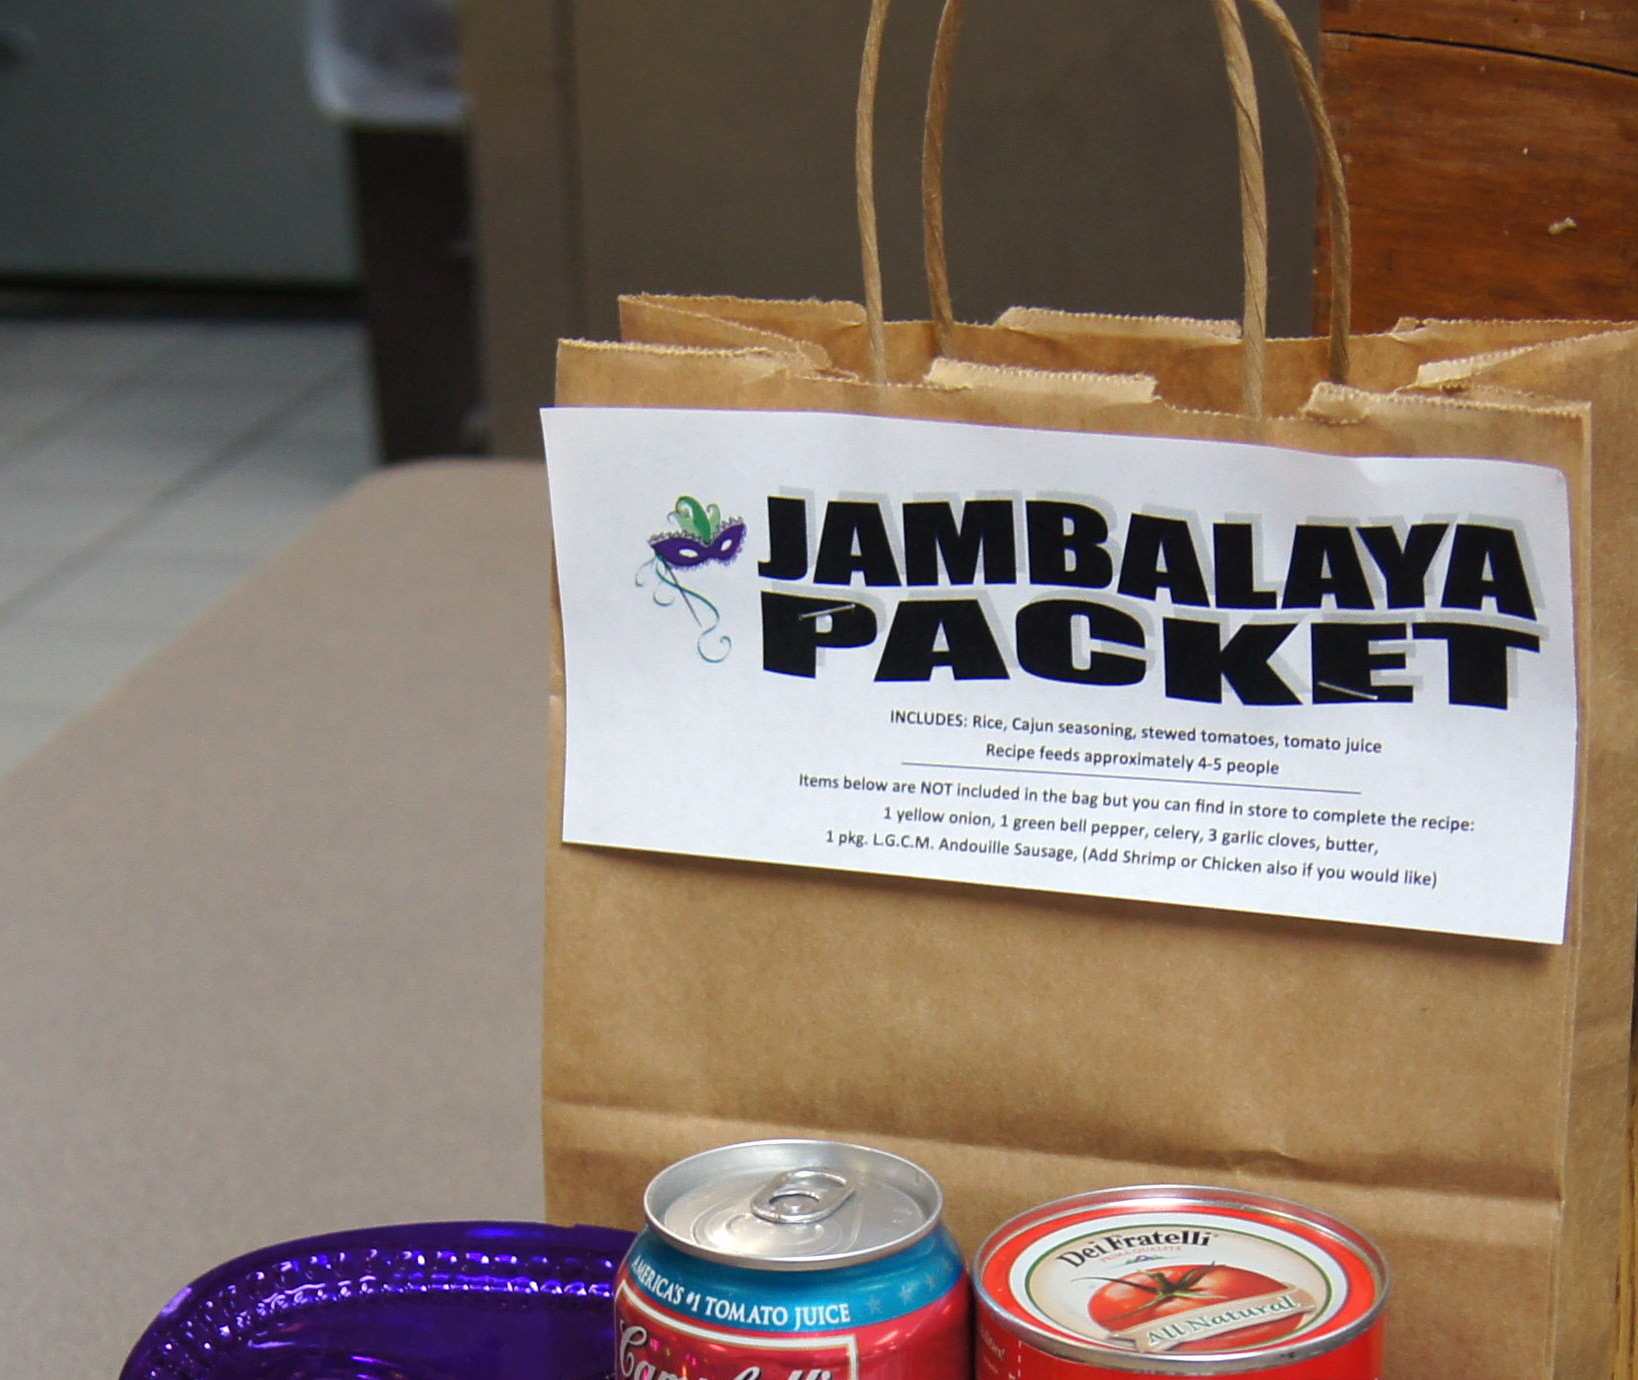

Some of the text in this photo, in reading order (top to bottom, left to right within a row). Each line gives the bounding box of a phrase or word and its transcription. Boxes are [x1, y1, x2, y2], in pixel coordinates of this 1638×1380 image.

[757, 496, 1537, 620] JAMBALAYA
[761, 590, 1540, 711] PACKET
[891, 710, 1382, 754] INCLUDES: Rice, Cajun seasoning, stewed tomatoes, tomato juice
[986, 744, 1279, 777] Recipe feeds approximately 4-5 people
[799, 774, 1474, 834] Items below are NOT included in the bag but you can find in store to complete the recipe:
[884, 807, 1378, 856] 1 yellow onion, 1 green bell pepper, celery, 3 garlic cloves, butter,
[827, 830, 1437, 889] 1 pkg. L.G.C.M. Andouille Sausage, (Add Shrimp or Chicken also if you would like)
[1056, 1230, 1212, 1268] Dei Fratelli
[630, 1255, 851, 1331] AMERICA'S #1 TOMATO JUICE
[1147, 1296, 1301, 1346] All Natural
